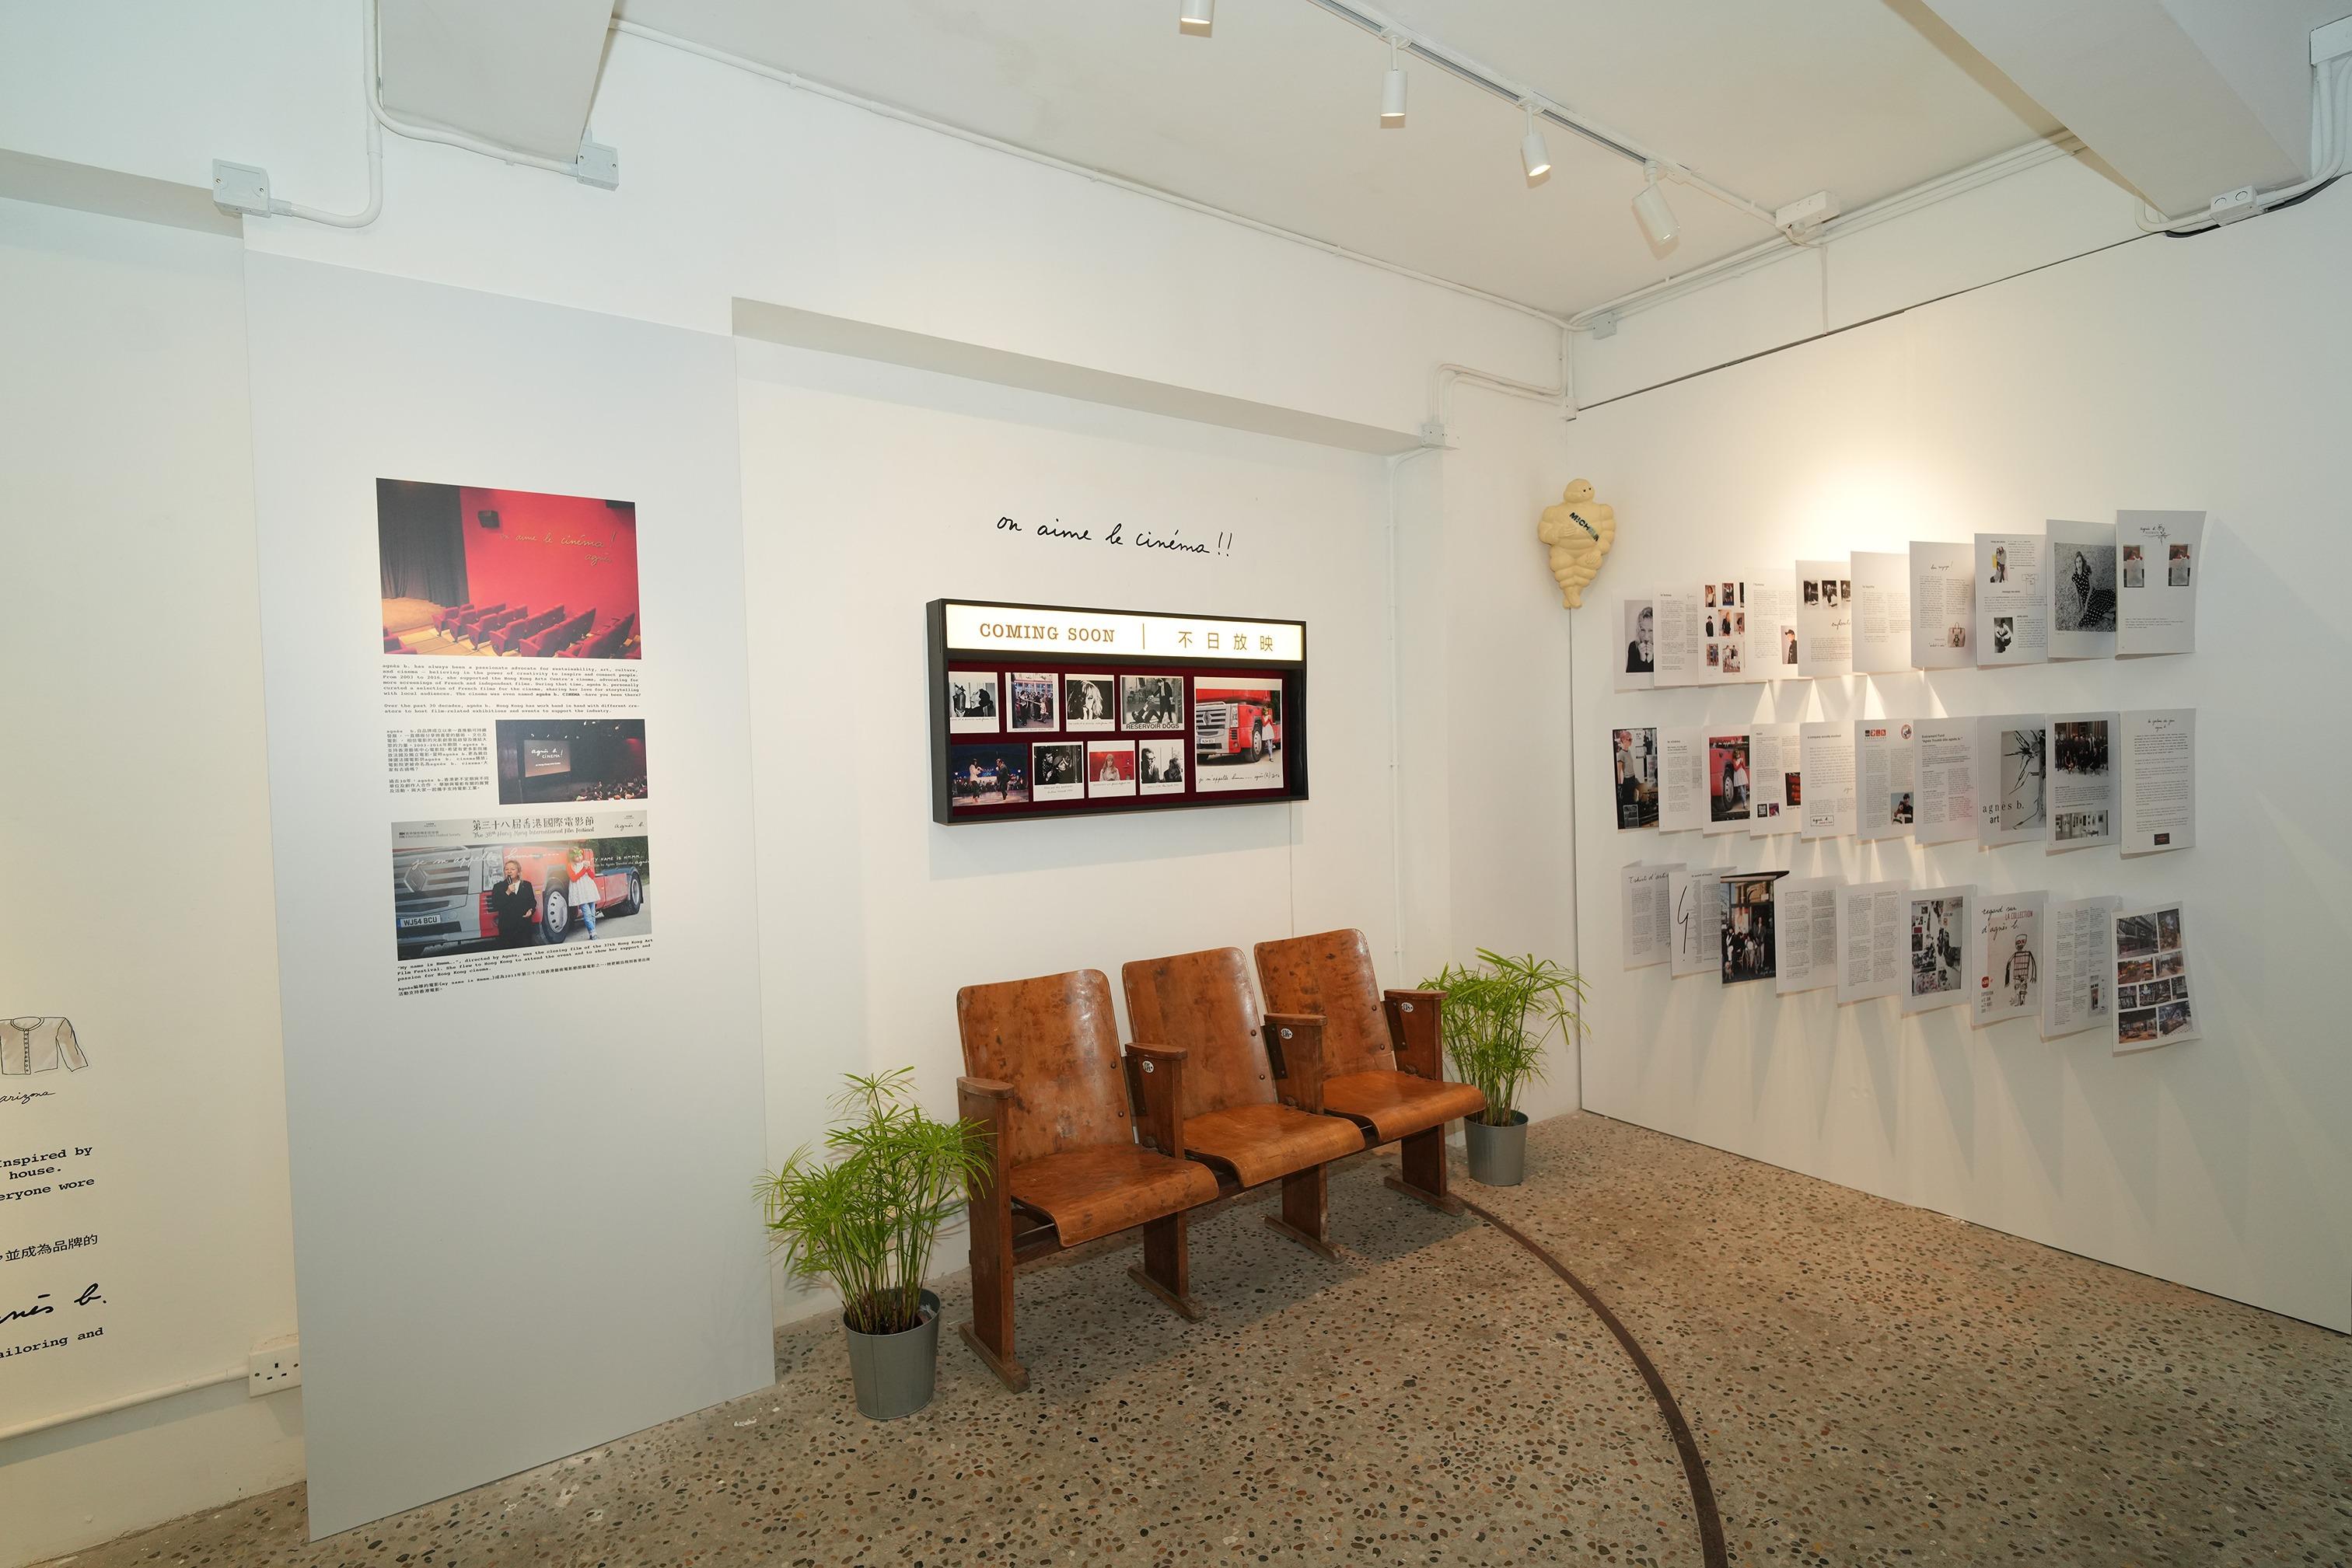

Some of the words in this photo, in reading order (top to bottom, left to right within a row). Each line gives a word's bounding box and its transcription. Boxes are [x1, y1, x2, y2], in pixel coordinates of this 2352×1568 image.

[997, 516, 1022, 531] on
[1037, 518, 1092, 541] aime
[1105, 523, 1123, 545] le
[979, 623, 1059, 640] COMING
[1068, 626, 1115, 643] SOON
[1178, 630, 1273, 652] 不日放映
[1982, 801, 2013, 814] agnès
[2016, 800, 2024, 809] b.
[472, 816, 594, 832] 第三十八屆香港國際電影節
[1990, 815, 2000, 824] art
[1981, 906, 2003, 920] regard
[2011, 910, 2033, 919] COLLECTION
[0, 1091, 56, 1104] arizona
[75, 1147, 93, 1156] by
[9, 1167, 61, 1180] house.
[59, 1179, 95, 1190] wore
[74, 1283, 107, 1306] b.
[77, 1327, 104, 1340] and
